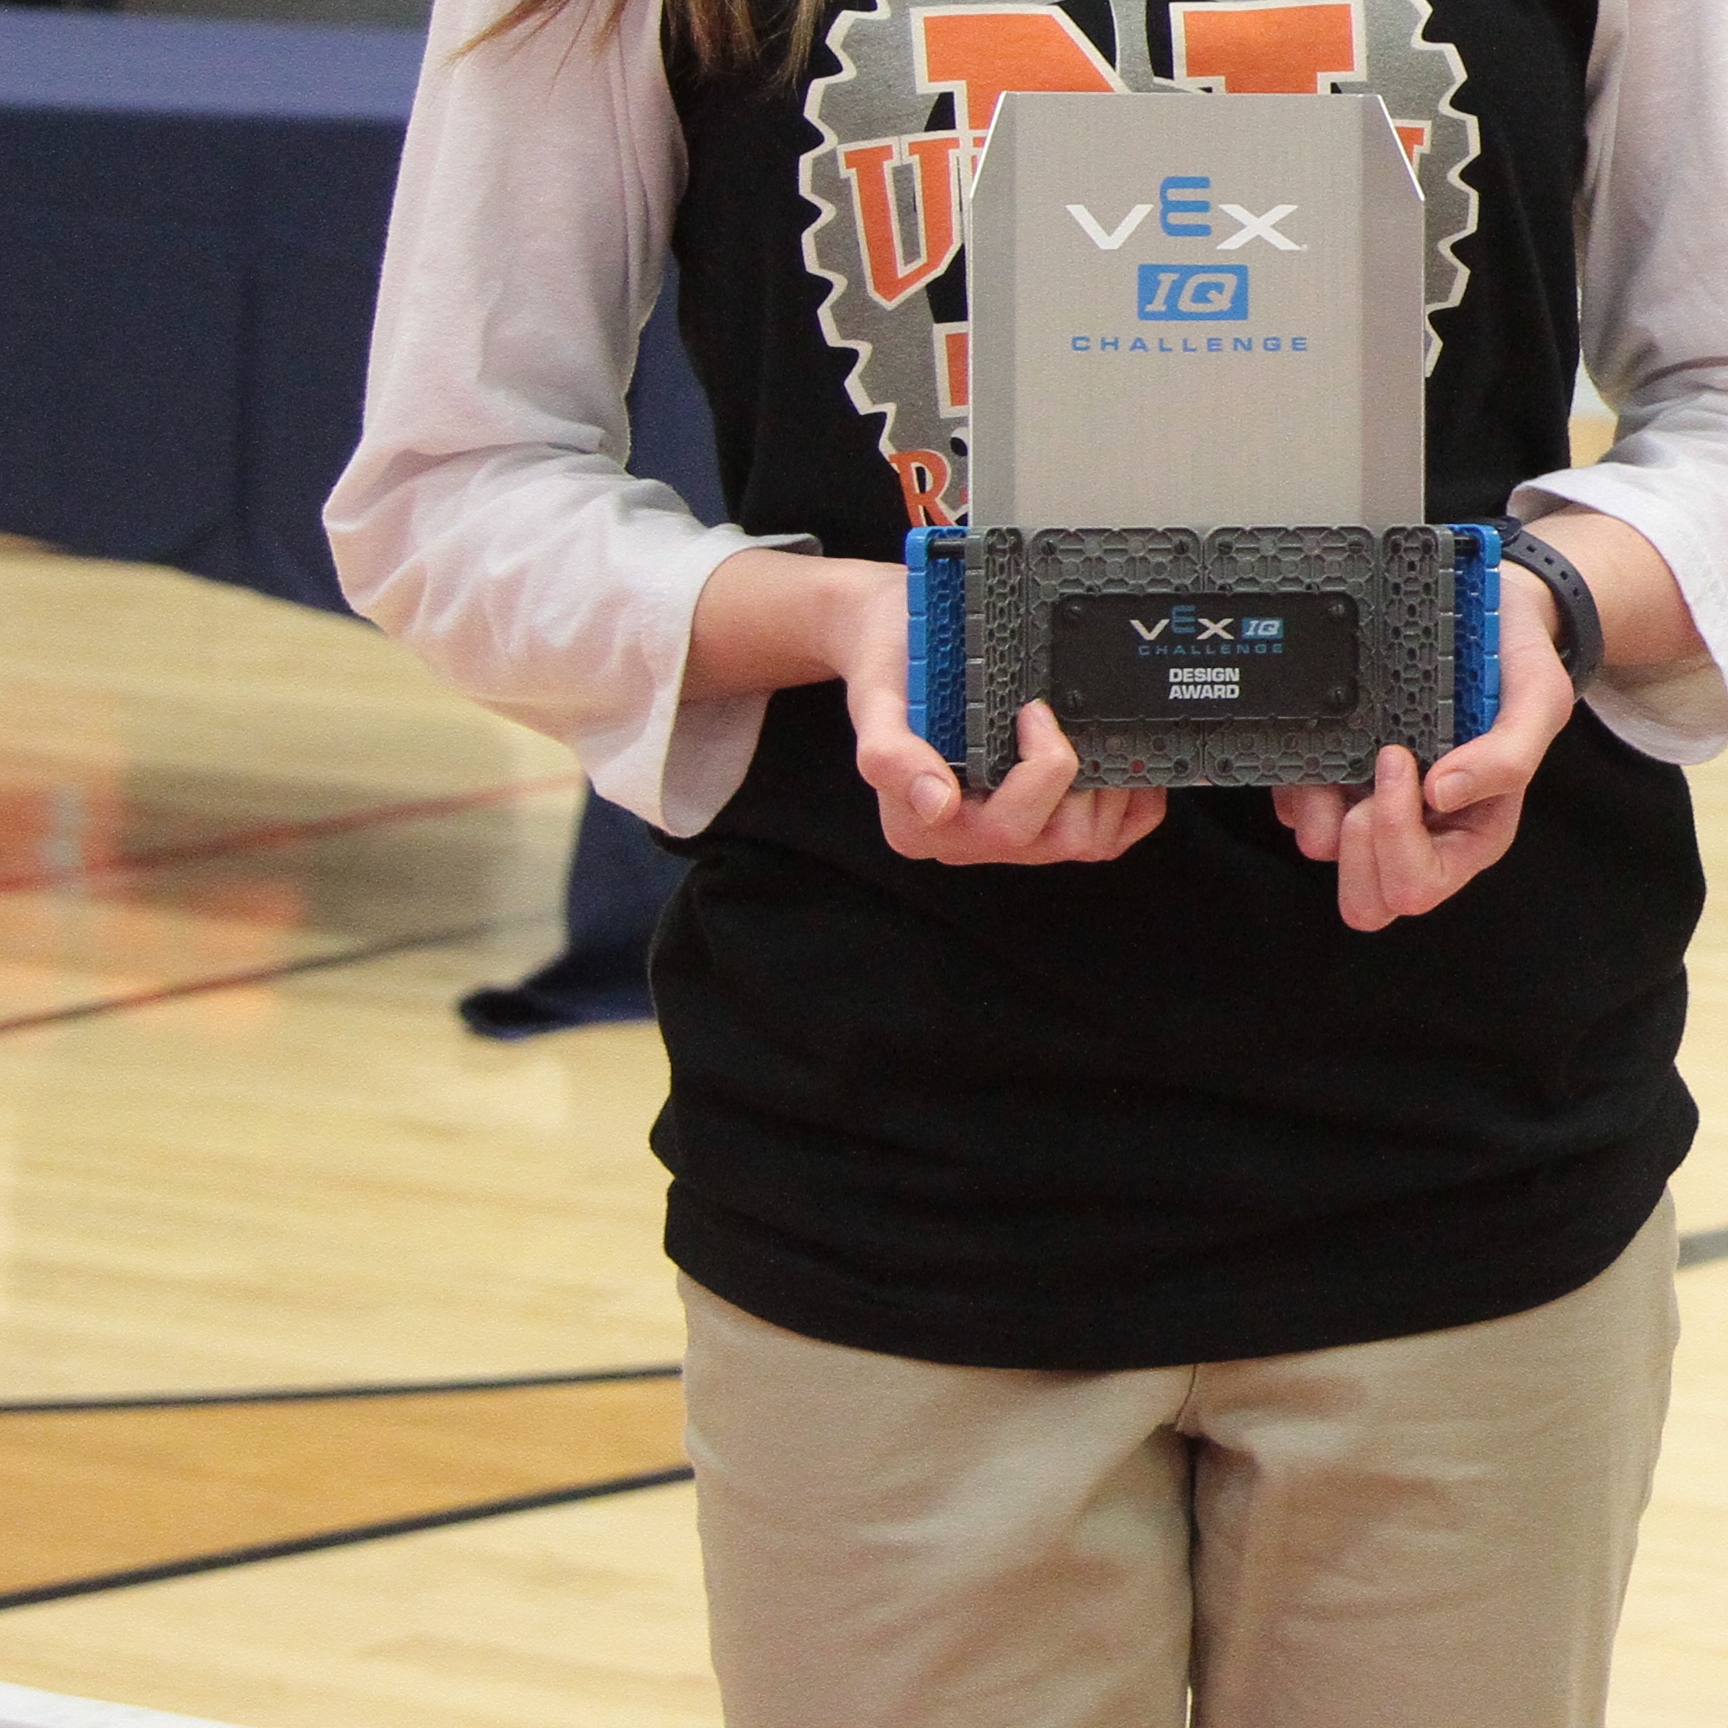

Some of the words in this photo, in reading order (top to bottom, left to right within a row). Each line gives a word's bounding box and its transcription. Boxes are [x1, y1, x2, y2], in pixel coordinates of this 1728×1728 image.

[1064, 175, 1304, 251] VEX
[1144, 272, 1239, 313] IQ
[1070, 335, 1309, 353] CHALLENGE
[1130, 605, 1235, 641] VEX
[1243, 619, 1281, 637] IQ
[1138, 643, 1284, 656] CHALLENGE
[1168, 668, 1240, 683] DESIGN
[1168, 684, 1240, 700] AWARD
